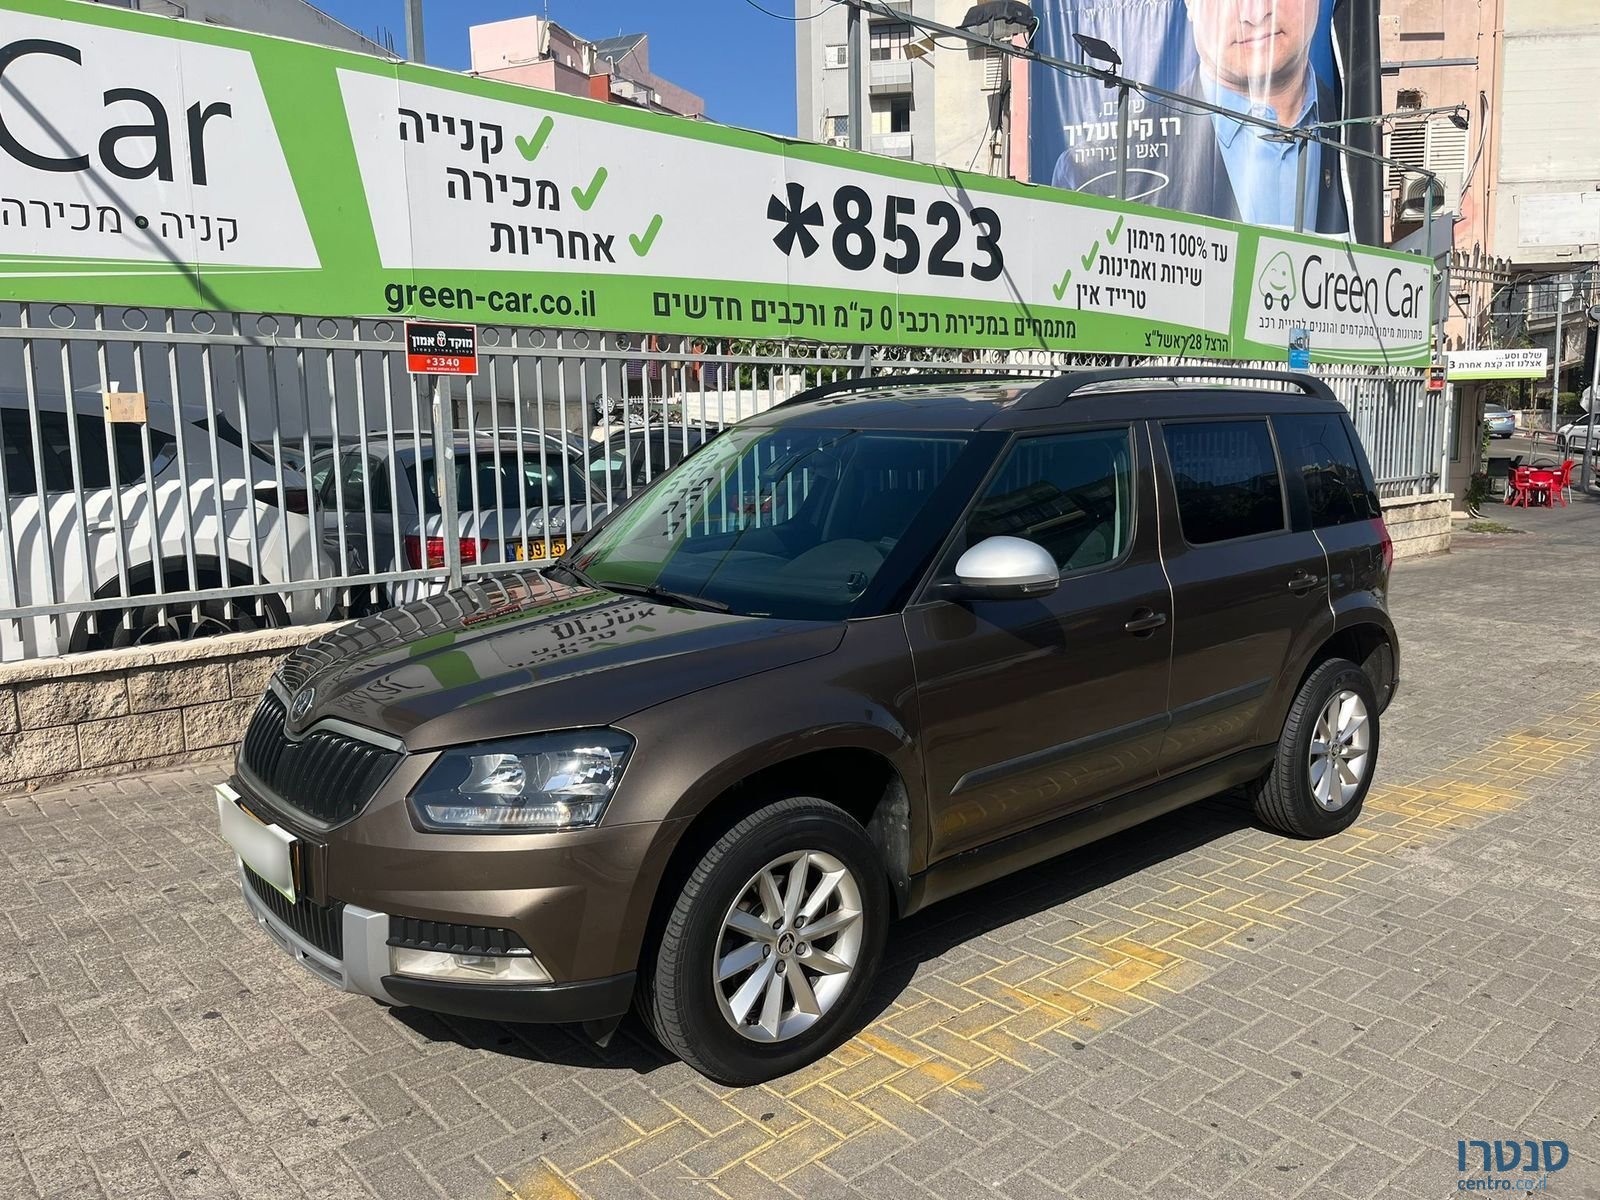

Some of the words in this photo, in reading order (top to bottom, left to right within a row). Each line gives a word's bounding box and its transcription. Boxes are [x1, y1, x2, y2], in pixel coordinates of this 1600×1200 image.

[0, 38, 232, 186] Car
[398, 108, 503, 164] קנייה
[1160, 117, 1181, 137] רז
[1075, 145, 1130, 163] עירייה
[1136, 143, 1168, 159] ראש
[446, 167, 560, 211] מכירה
[1, 198, 122, 233] מכירה
[161, 212, 238, 251] קניה
[490, 222, 616, 263] אחריות
[1127, 228, 1165, 254] מימון
[1170, 233, 1208, 259] 100%
[1211, 243, 1228, 262] עד
[1099, 255, 1156, 281] ואמינות
[1160, 263, 1202, 287] שירות
[384, 282, 596, 317] green-car.co.il
[1076, 283, 1100, 310] אין
[1105, 286, 1146, 309] טרייד
[1301, 254, 1378, 315] Green
[1385, 268, 1423, 319] Car
[653, 292, 742, 321] חדשים
[752, 299, 825, 326] ורכבים
[880, 305, 893, 331] 0
[898, 311, 939, 333] רכבי
[946, 313, 1009, 336] במכירת
[1015, 317, 1076, 339] מתמחים
[411, 335, 435, 347] אמון
[447, 337, 473, 350] מוקד
[1189, 333, 1202, 350] 28
[1204, 334, 1229, 352] הרצל
